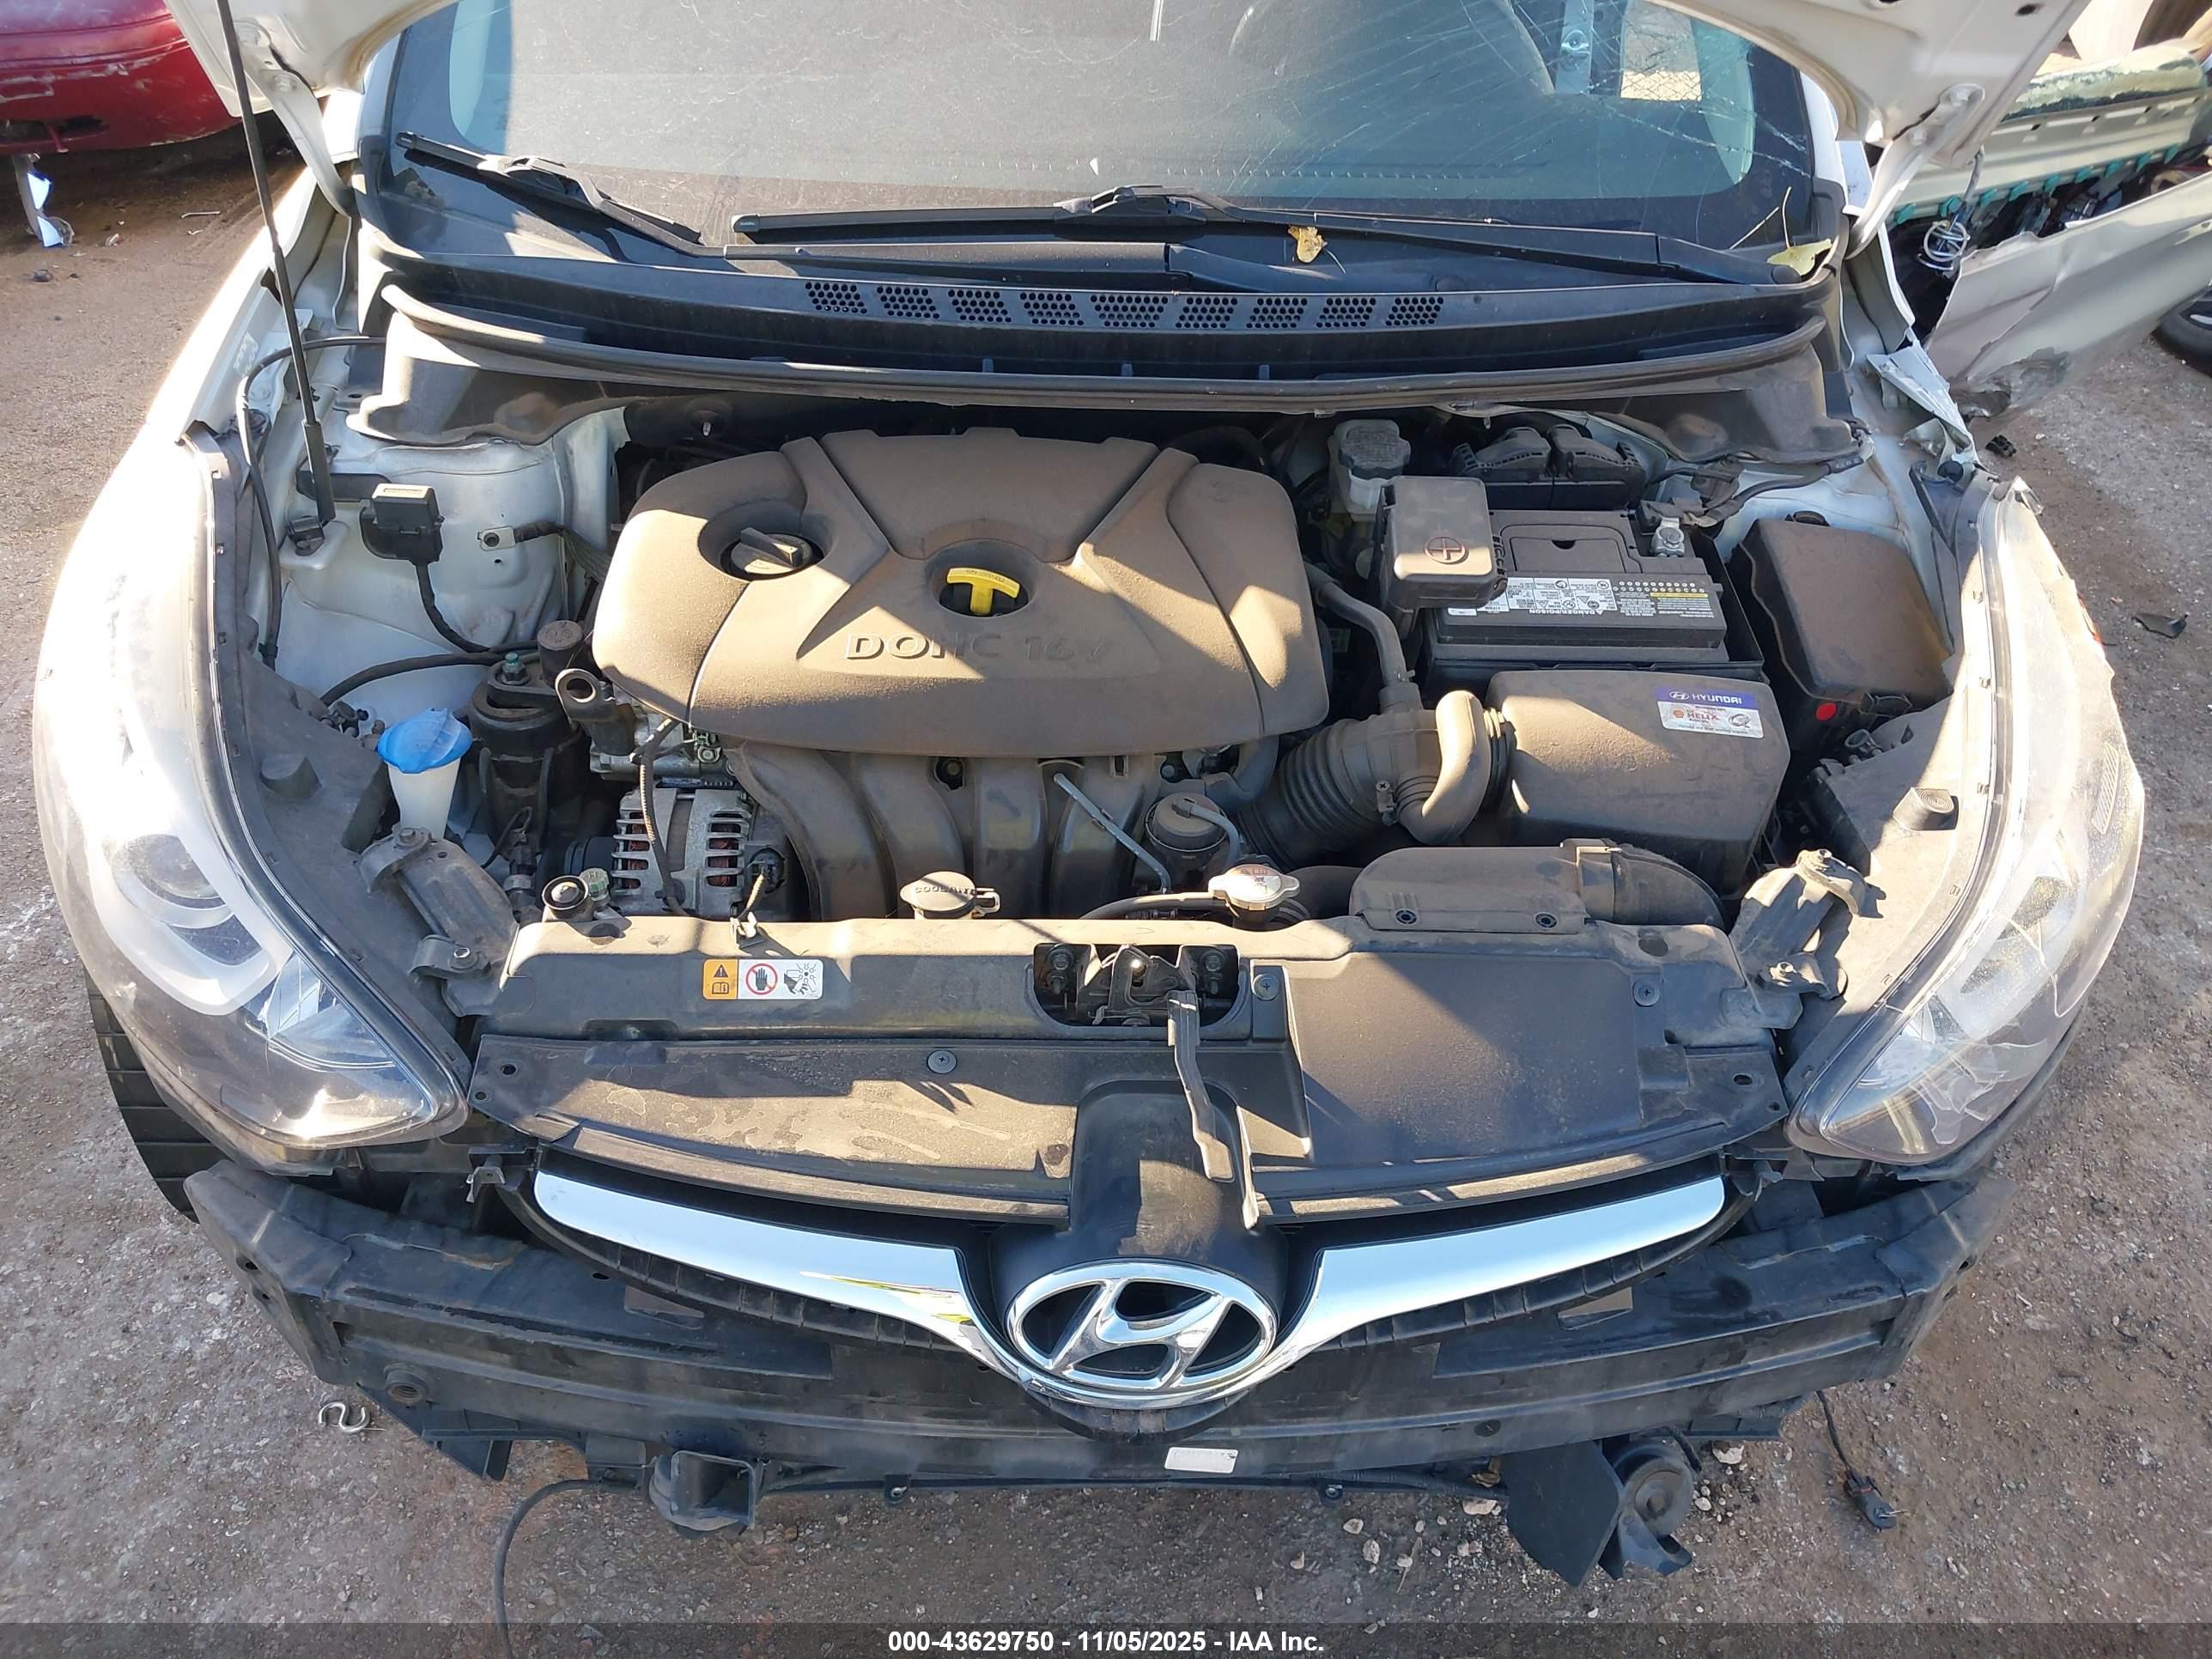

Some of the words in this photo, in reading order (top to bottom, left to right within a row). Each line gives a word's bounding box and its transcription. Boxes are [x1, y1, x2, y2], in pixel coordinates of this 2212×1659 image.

[845, 633, 1001, 659] DOHC
[1692, 693, 1742, 704] HYUNDAI
[915, 885, 975, 895] COOLANT
